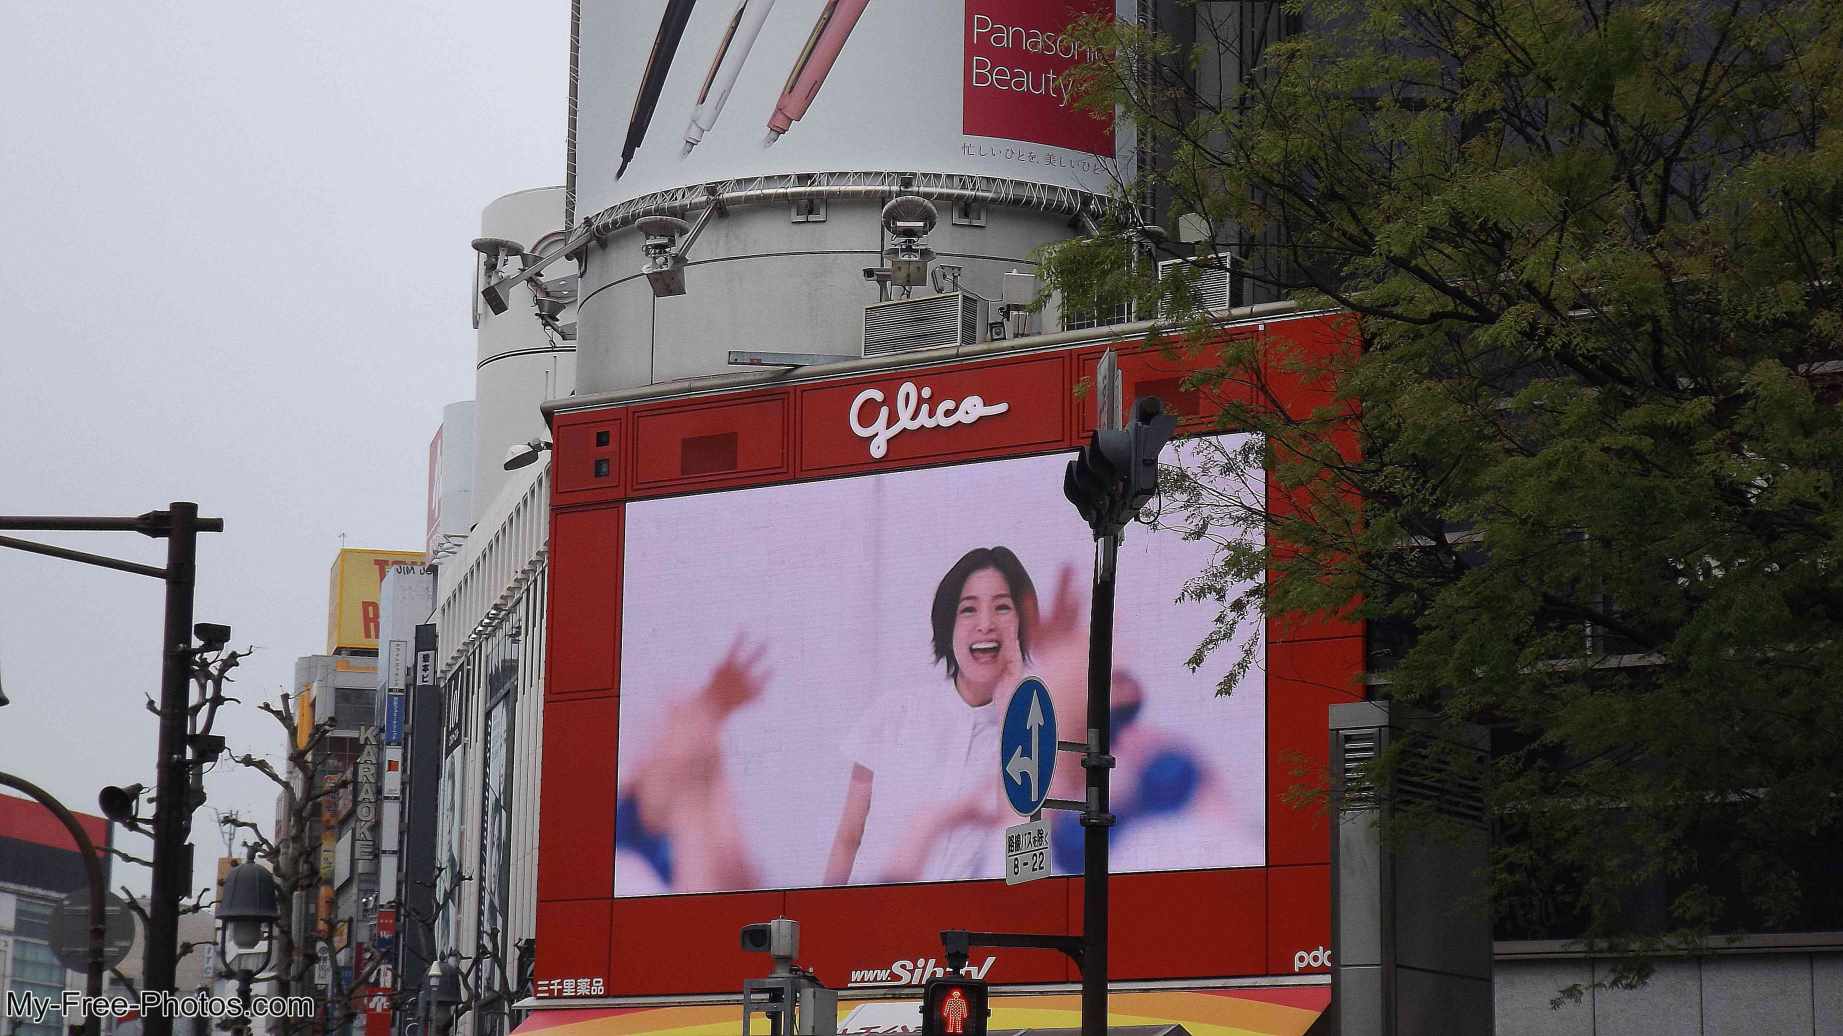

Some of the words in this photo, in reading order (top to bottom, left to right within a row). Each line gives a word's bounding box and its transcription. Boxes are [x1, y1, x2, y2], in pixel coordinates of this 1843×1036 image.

[972, 56, 1073, 107] Beauty
[850, 382, 1009, 459] Glico
[355, 726, 377, 860] KARAOKE
[536, 978, 604, 997] 三千里薬品
